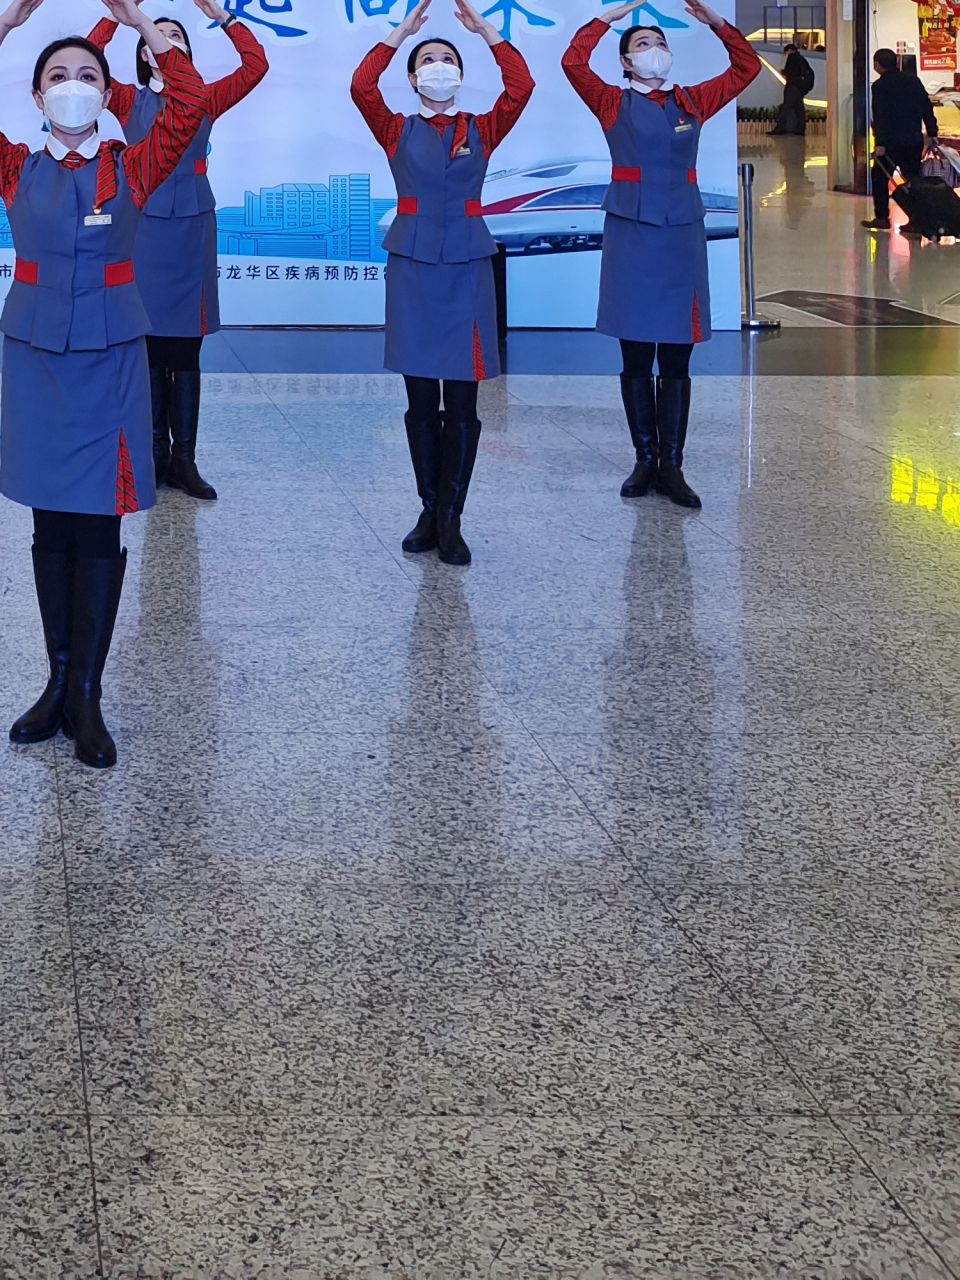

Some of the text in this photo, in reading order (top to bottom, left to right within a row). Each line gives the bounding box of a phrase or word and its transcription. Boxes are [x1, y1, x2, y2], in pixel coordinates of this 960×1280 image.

[217, 264, 387, 281] 龙华区疾病预防控
